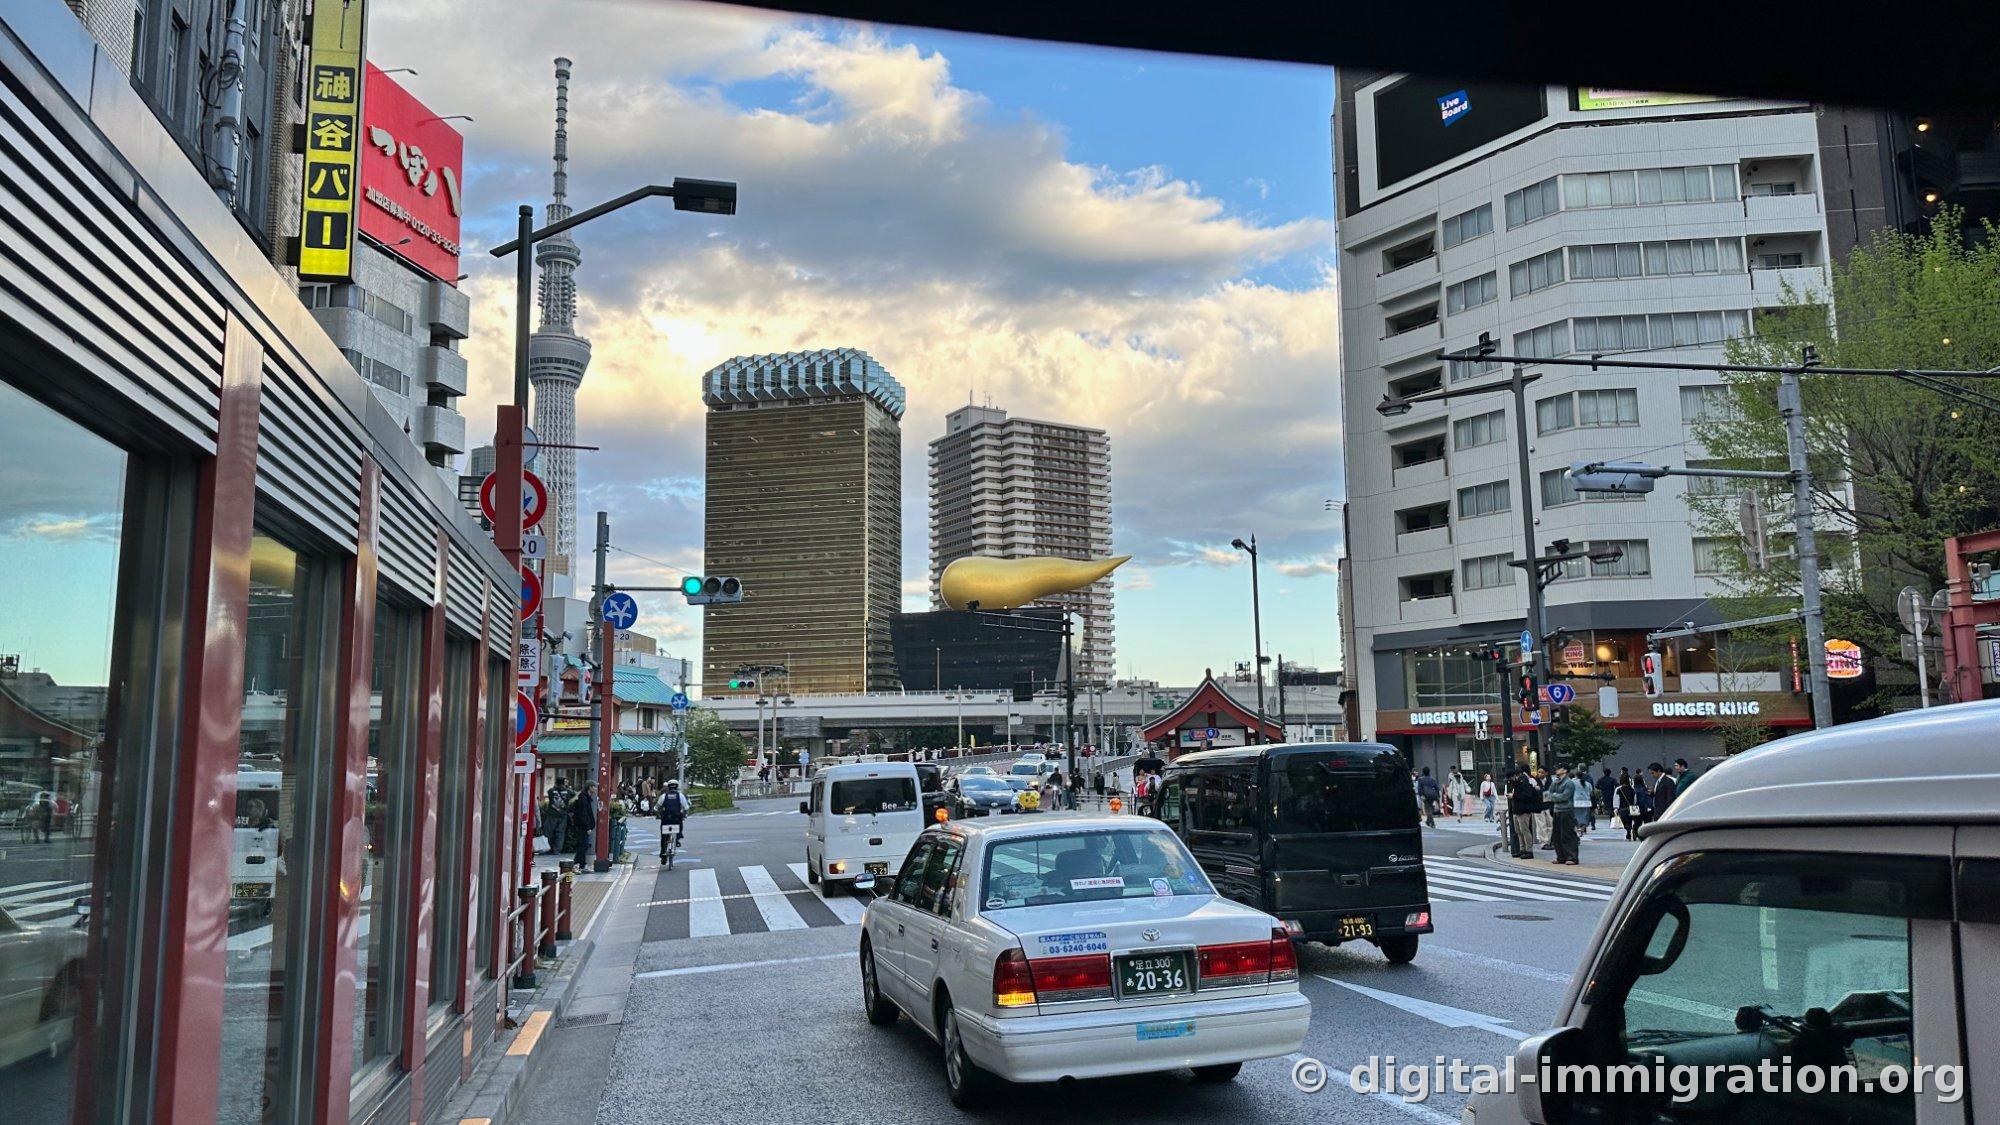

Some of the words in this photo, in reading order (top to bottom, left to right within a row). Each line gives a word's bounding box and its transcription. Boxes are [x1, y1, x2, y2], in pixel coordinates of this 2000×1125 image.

[1441, 97, 1460, 110] Live
[1441, 101, 1468, 120] Board
[310, 70, 351, 246] 神谷バー
[1553, 687, 1562, 699] 6
[1652, 702, 1716, 717] BURGER
[1719, 701, 1760, 715] KING
[1410, 711, 1456, 725] BURGER
[882, 802, 898, 810] Bee
[1343, 923, 1373, 937] 21-93
[1135, 960, 1154, 970] 足立
[1154, 957, 1171, 969] 300
[1126, 977, 1135, 987] あ
[1135, 969, 1184, 991] 20-36
